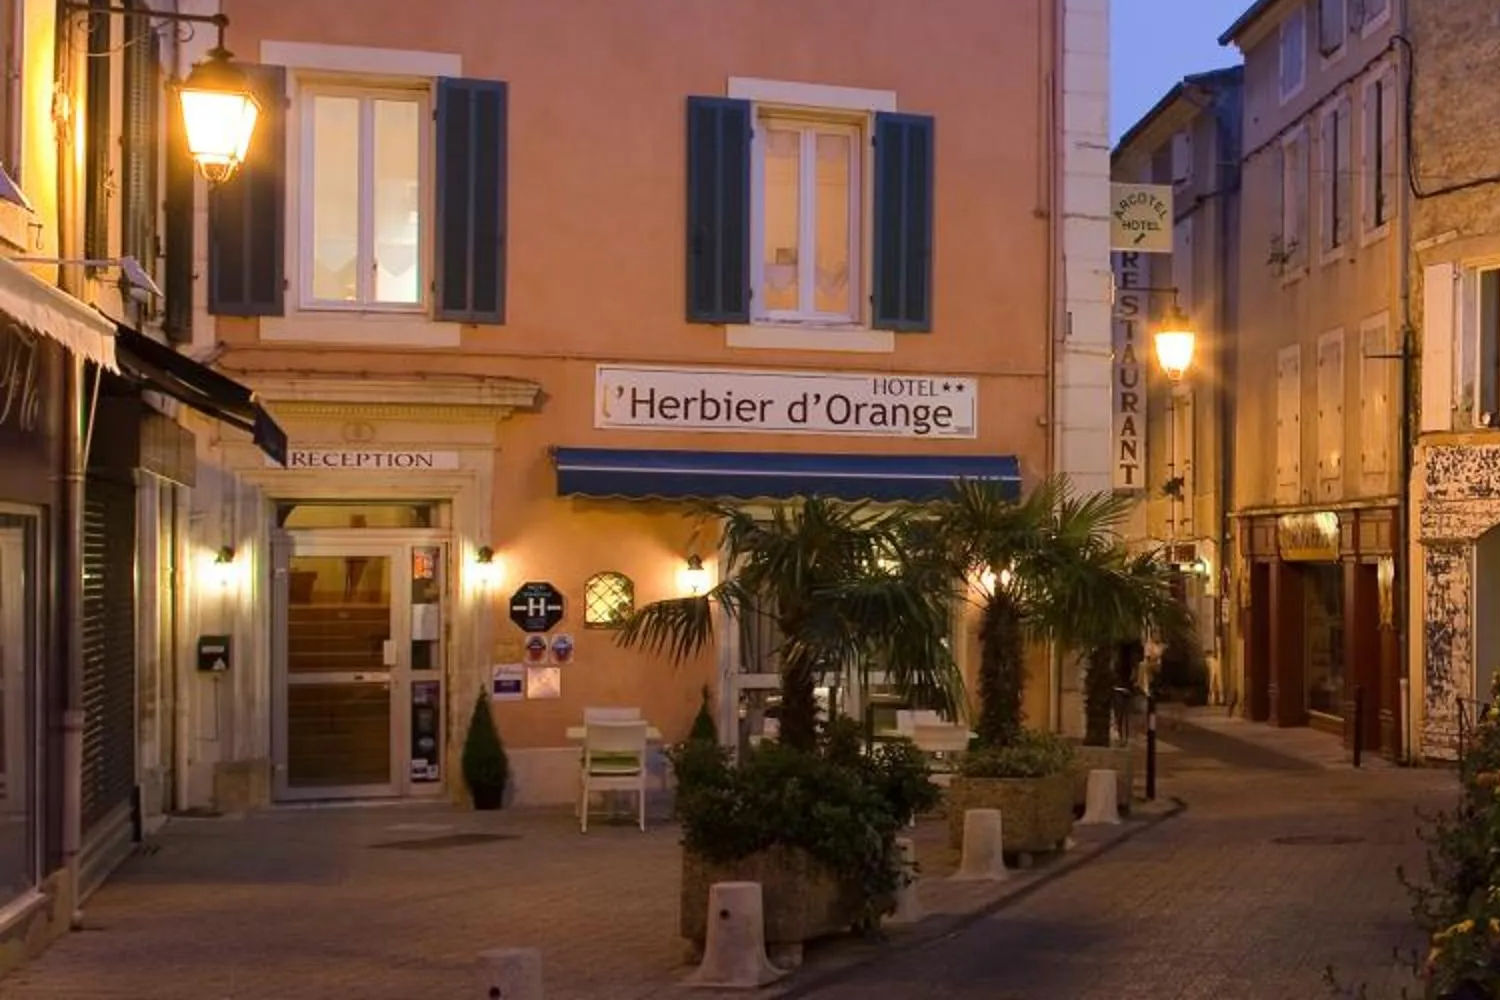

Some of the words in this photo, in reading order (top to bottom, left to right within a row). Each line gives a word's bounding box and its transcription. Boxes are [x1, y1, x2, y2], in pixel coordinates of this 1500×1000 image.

[1114, 192, 1168, 220] ARCOTEL
[1121, 219, 1162, 231] HOTEL
[1119, 251, 1140, 485] RESTAURANT
[872, 378, 940, 397] HOTEL
[787, 393, 953, 435] d'Orange
[291, 452, 434, 468] RECEPTION
[527, 597, 545, 617] H
